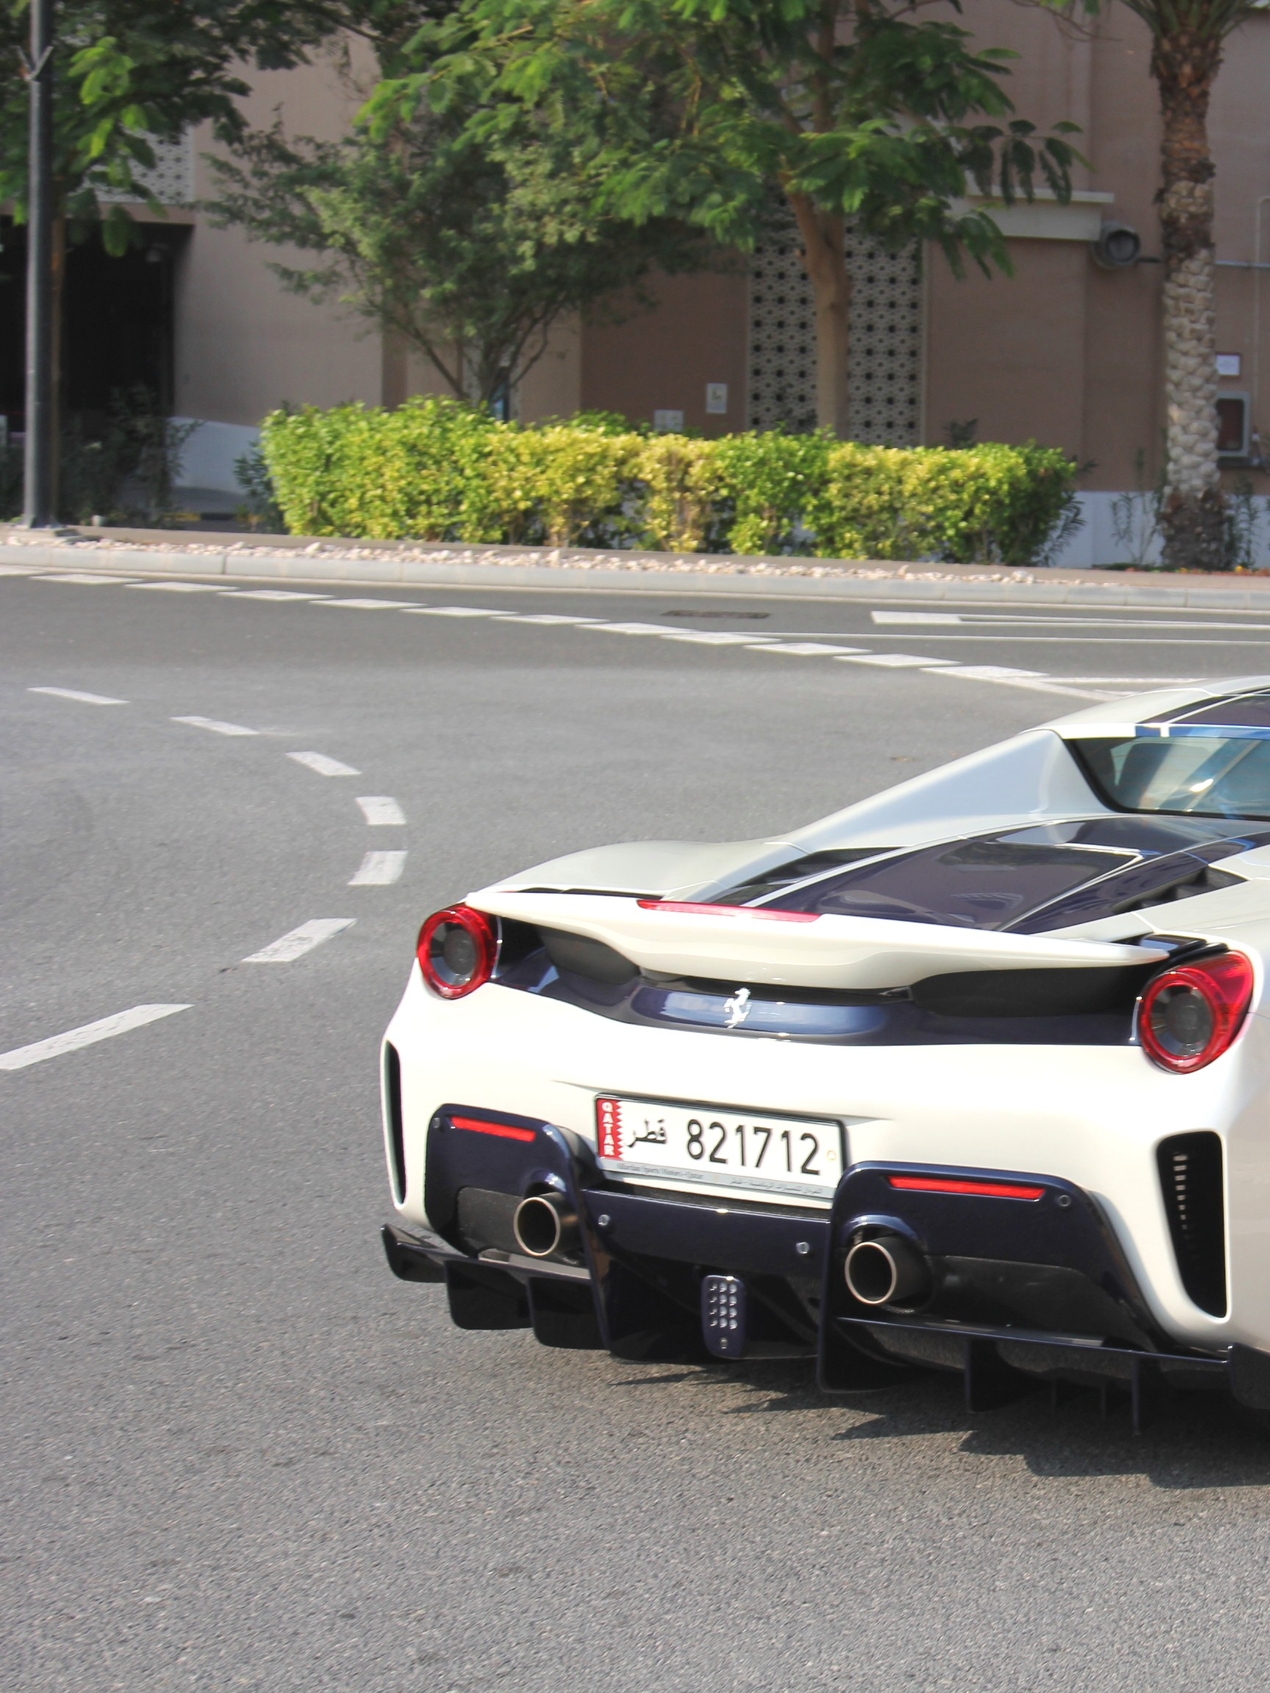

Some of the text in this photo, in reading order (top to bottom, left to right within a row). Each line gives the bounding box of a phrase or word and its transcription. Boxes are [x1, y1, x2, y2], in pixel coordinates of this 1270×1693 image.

[601, 1101, 615, 1156] QATAR
[626, 1118, 667, 1148] قطر
[687, 1118, 821, 1176] 821712
